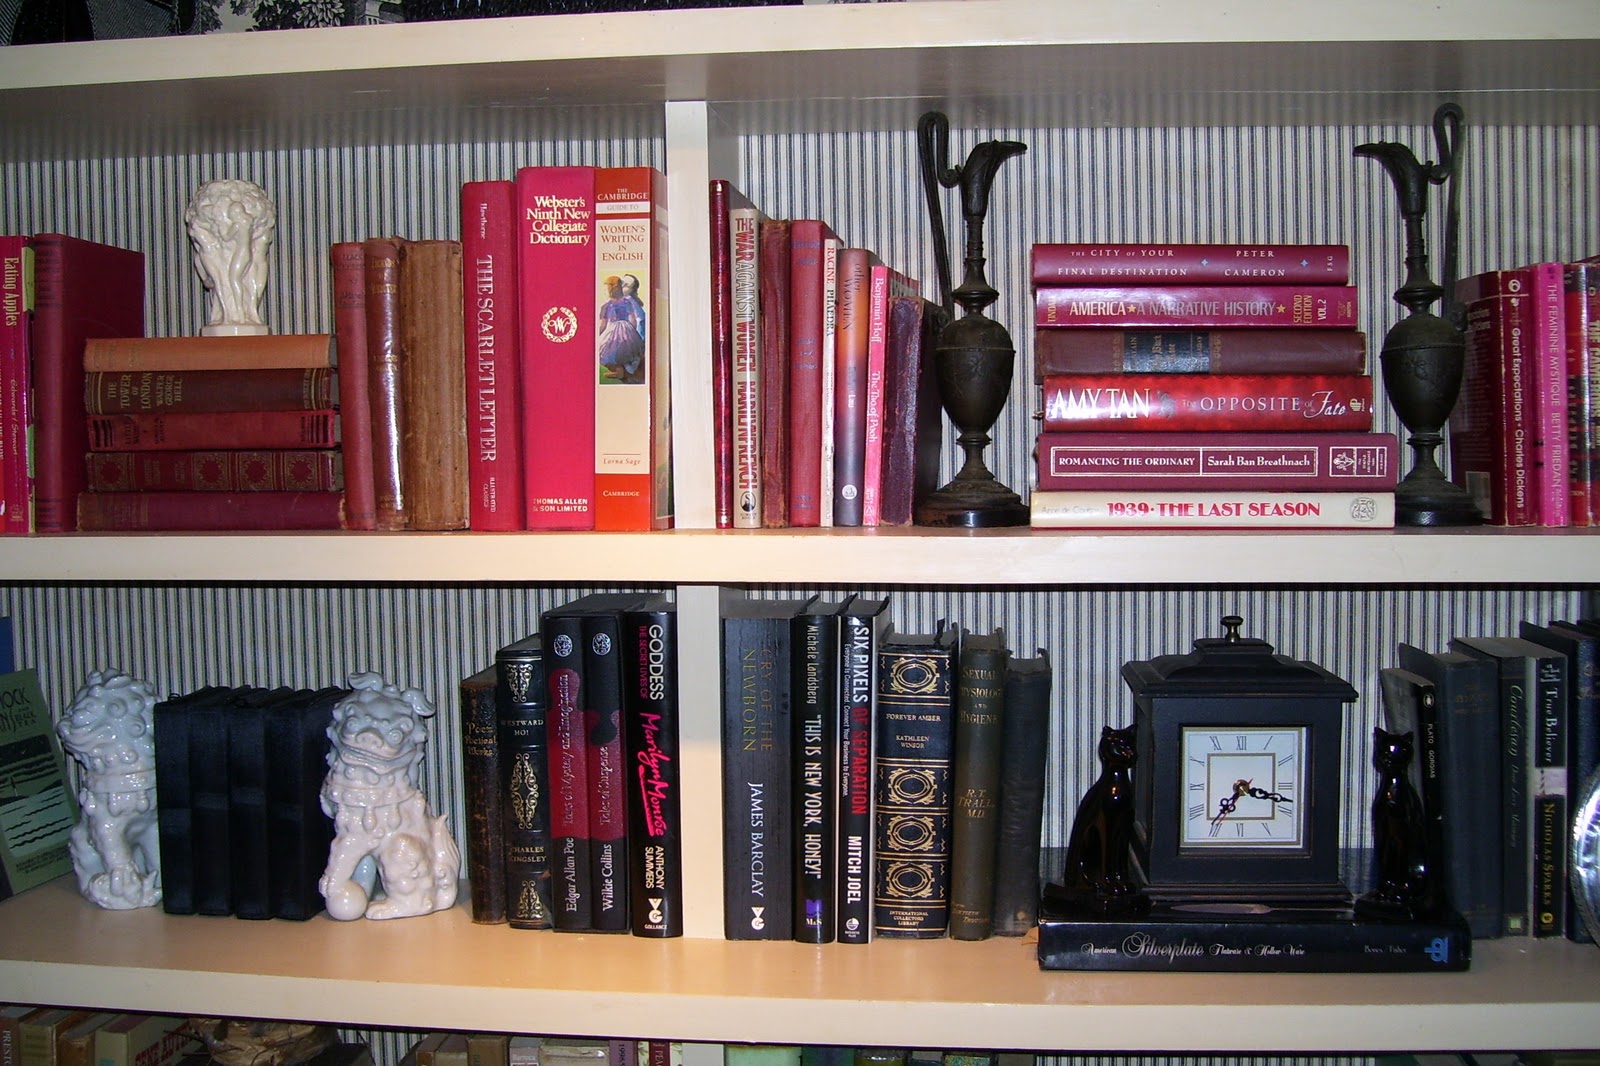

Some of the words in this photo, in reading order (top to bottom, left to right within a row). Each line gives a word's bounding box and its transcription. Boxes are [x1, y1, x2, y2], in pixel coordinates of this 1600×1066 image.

[533, 194, 587, 208] Webster's
[597, 192, 649, 201] CAMBRIDGE
[607, 203, 628, 211] GUIDE
[630, 203, 640, 211] TO
[480, 202, 488, 240] Hawthorne
[526, 207, 562, 220] Ninth
[564, 207, 591, 220] New
[532, 219, 589, 235] Collegiate
[735, 217, 755, 231] THE
[529, 232, 591, 247] Dictionary
[600, 225, 647, 234] WOMEN'S
[601, 235, 645, 243] WRITING
[602, 252, 644, 261] ENGLISH
[735, 230, 755, 261] WAR
[1090, 249, 1120, 257] CITY
[1141, 249, 1175, 257] YOUR
[1236, 250, 1275, 258] PETER
[3, 256, 19, 290] Eating
[477, 254, 494, 294] THE
[826, 247, 836, 286] RACINE
[854, 262, 865, 293] other
[1057, 268, 1094, 276] FINAL
[1101, 268, 1188, 276] DESTINATION
[1224, 269, 1286, 277] CAMERON
[735, 261, 756, 321] AGAINST
[843, 279, 855, 332] WOMEN
[873, 277, 884, 320] Benjamin
[1547, 283, 1558, 302] THE
[4, 291, 18, 327] Apples
[826, 289, 835, 337] PHAEDRA
[1069, 301, 1127, 316] AMERICA
[1136, 301, 1146, 316] A
[1149, 301, 1220, 316] NARRATIVE
[1224, 301, 1277, 316] HISTORY
[1293, 294, 1303, 324] SECOND
[1303, 294, 1313, 324] EDITION
[477, 298, 496, 385] SCARLET
[871, 322, 882, 344] Hoff
[1511, 327, 1522, 356] Great
[1548, 305, 1559, 354] FEMININE
[1589, 320, 1600, 343] THE
[736, 321, 757, 373] WOMEN
[108, 382, 117, 400] THE
[121, 374, 131, 409] TOWER
[133, 385, 139, 396] OF
[142, 372, 153, 410] LONDON
[156, 375, 164, 407] WALTER
[175, 380, 184, 402] BELL
[871, 370, 881, 389] The
[1512, 357, 1524, 422] Expectations
[1549, 356, 1561, 407] MYSTIQUE
[737, 380, 757, 436] MARILYN
[867, 406, 879, 418] of
[870, 389, 880, 407] Tao
[1049, 388, 1102, 420] AMY
[1105, 388, 1151, 420] TAN
[1199, 396, 1302, 412] OPPOSITE
[1303, 390, 1347, 419] Fate
[11, 423, 19, 456] Stewart
[479, 388, 497, 462] LETTER
[868, 419, 879, 444] Pooh
[1551, 412, 1561, 442] BETTY
[625, 458, 642, 466] Sage
[738, 435, 758, 489] FRENCH
[1058, 457, 1120, 466] ROMANCING
[1122, 457, 1143, 466] THE
[1144, 457, 1196, 466] ORDINARY
[1206, 454, 1236, 467] Sarah
[1236, 455, 1256, 467] Ban
[1257, 454, 1311, 467] Breathnach
[1515, 429, 1525, 469] Charles
[1551, 444, 1563, 488] FRIEDAN
[1516, 469, 1526, 509] Dickens
[1155, 502, 1194, 517] THE
[1198, 502, 1244, 517] LAST
[1249, 502, 1321, 517] SEASON
[639, 624, 648, 638] THE
[806, 624, 819, 660] Michele
[853, 625, 870, 650] SIX
[639, 638, 649, 665] SECRET
[649, 623, 665, 701] GODDESS
[760, 648, 773, 683] CRY
[640, 665, 649, 687] LIVES
[806, 663, 820, 705] Landsberg
[852, 653, 869, 703] PIXELS
[640, 688, 649, 700] OF
[742, 649, 757, 752] NEWBORN
[760, 689, 773, 713] OF
[1545, 687, 1559, 715] True
[805, 714, 822, 743] "THIS
[852, 706, 869, 726] OF
[885, 713, 917, 721] FOREVER
[917, 714, 942, 722] AMBER
[1508, 684, 1524, 758] Courtesan
[638, 712, 671, 778] Marilyn
[760, 720, 773, 752] THE
[1236, 735, 1248, 751] XII
[1427, 722, 1435, 745] PLATO
[1545, 717, 1559, 764] Believer
[804, 746, 821, 756] IS
[1428, 749, 1437, 780] GORGIAS
[598, 746, 613, 789] Suspense
[804, 762, 822, 787] NEW
[850, 729, 868, 815] SEPARATION
[598, 789, 610, 800] of
[647, 775, 669, 838] Monroe
[747, 782, 763, 828] JAMES
[803, 791, 822, 827] YORK,
[599, 800, 611, 826] Tales
[564, 837, 574, 855] Poe
[1543, 802, 1555, 862] NICHOLAS
[564, 856, 576, 882] Allan
[600, 843, 613, 878] Collins
[645, 846, 654, 889] SUMMERS
[656, 845, 665, 890] ANTHONY
[751, 831, 765, 898] BARCLAY
[804, 834, 822, 879] HONEY!"
[847, 835, 862, 875] MITCH
[565, 882, 581, 912] Edgar
[602, 878, 614, 912] Wilkie
[847, 876, 861, 905] JOEL
[1543, 862, 1554, 906] SPARKS
[1079, 942, 1118, 956] American
[1120, 931, 1205, 964] Silverplate
